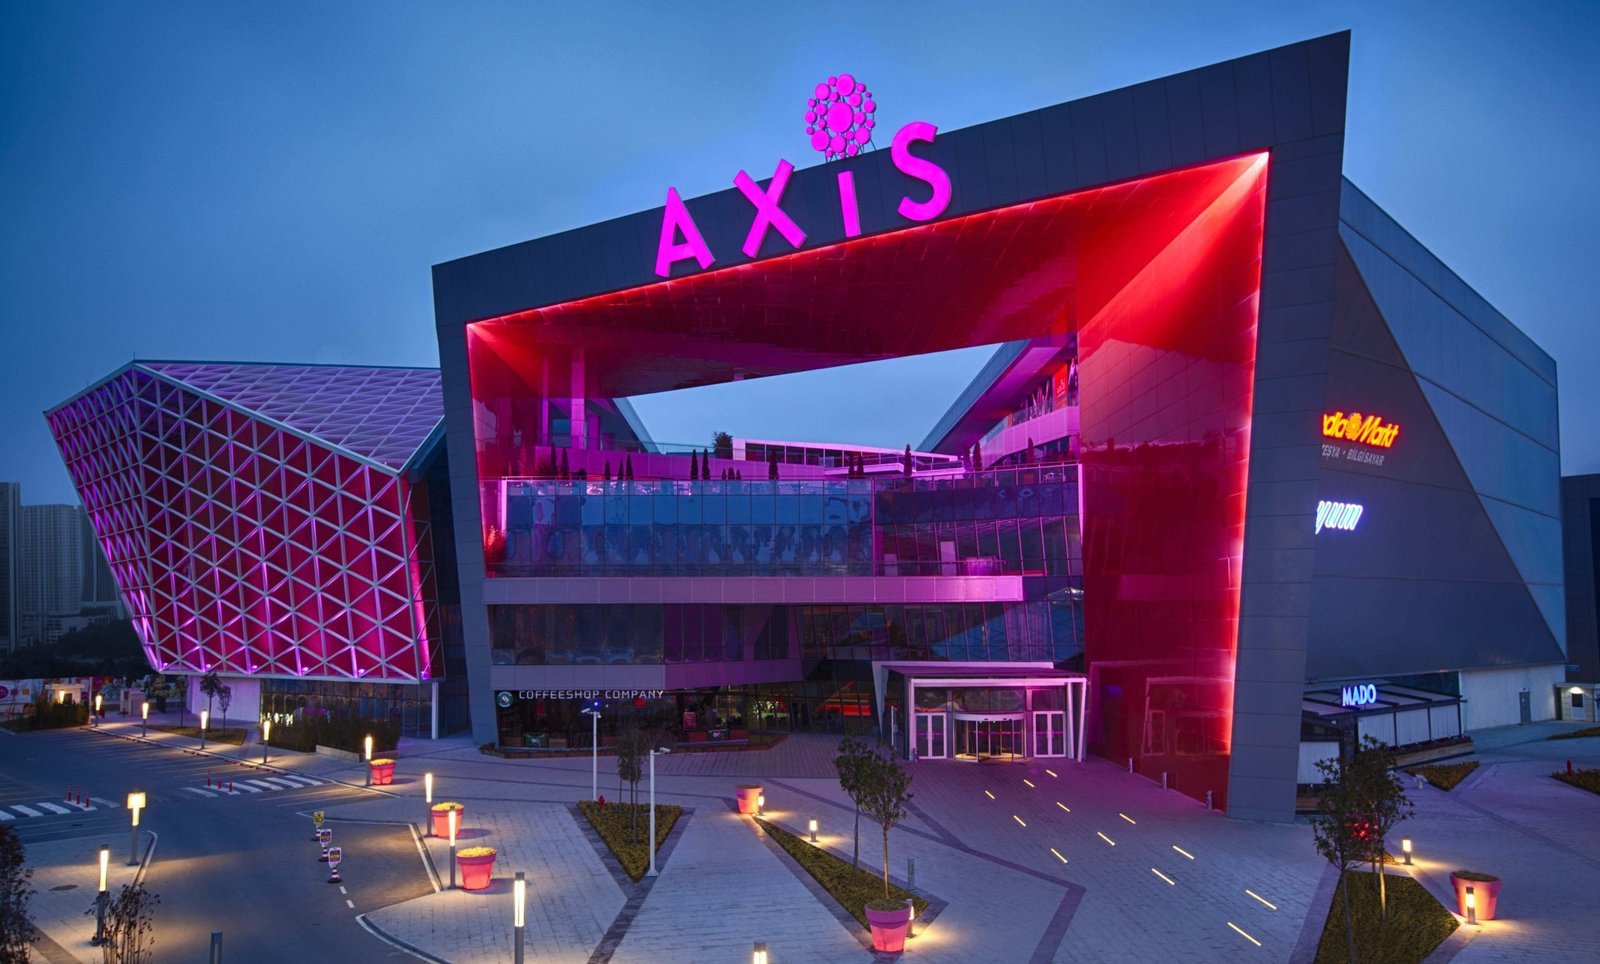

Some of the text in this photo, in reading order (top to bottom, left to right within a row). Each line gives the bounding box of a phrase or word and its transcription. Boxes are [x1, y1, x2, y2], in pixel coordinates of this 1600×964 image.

[654, 121, 952, 278] AXIS
[1353, 415, 1399, 448] Markt
[518, 690, 600, 700] COFFEESHOP
[605, 690, 664, 700] COMPANY
[1342, 683, 1377, 707] MADO
